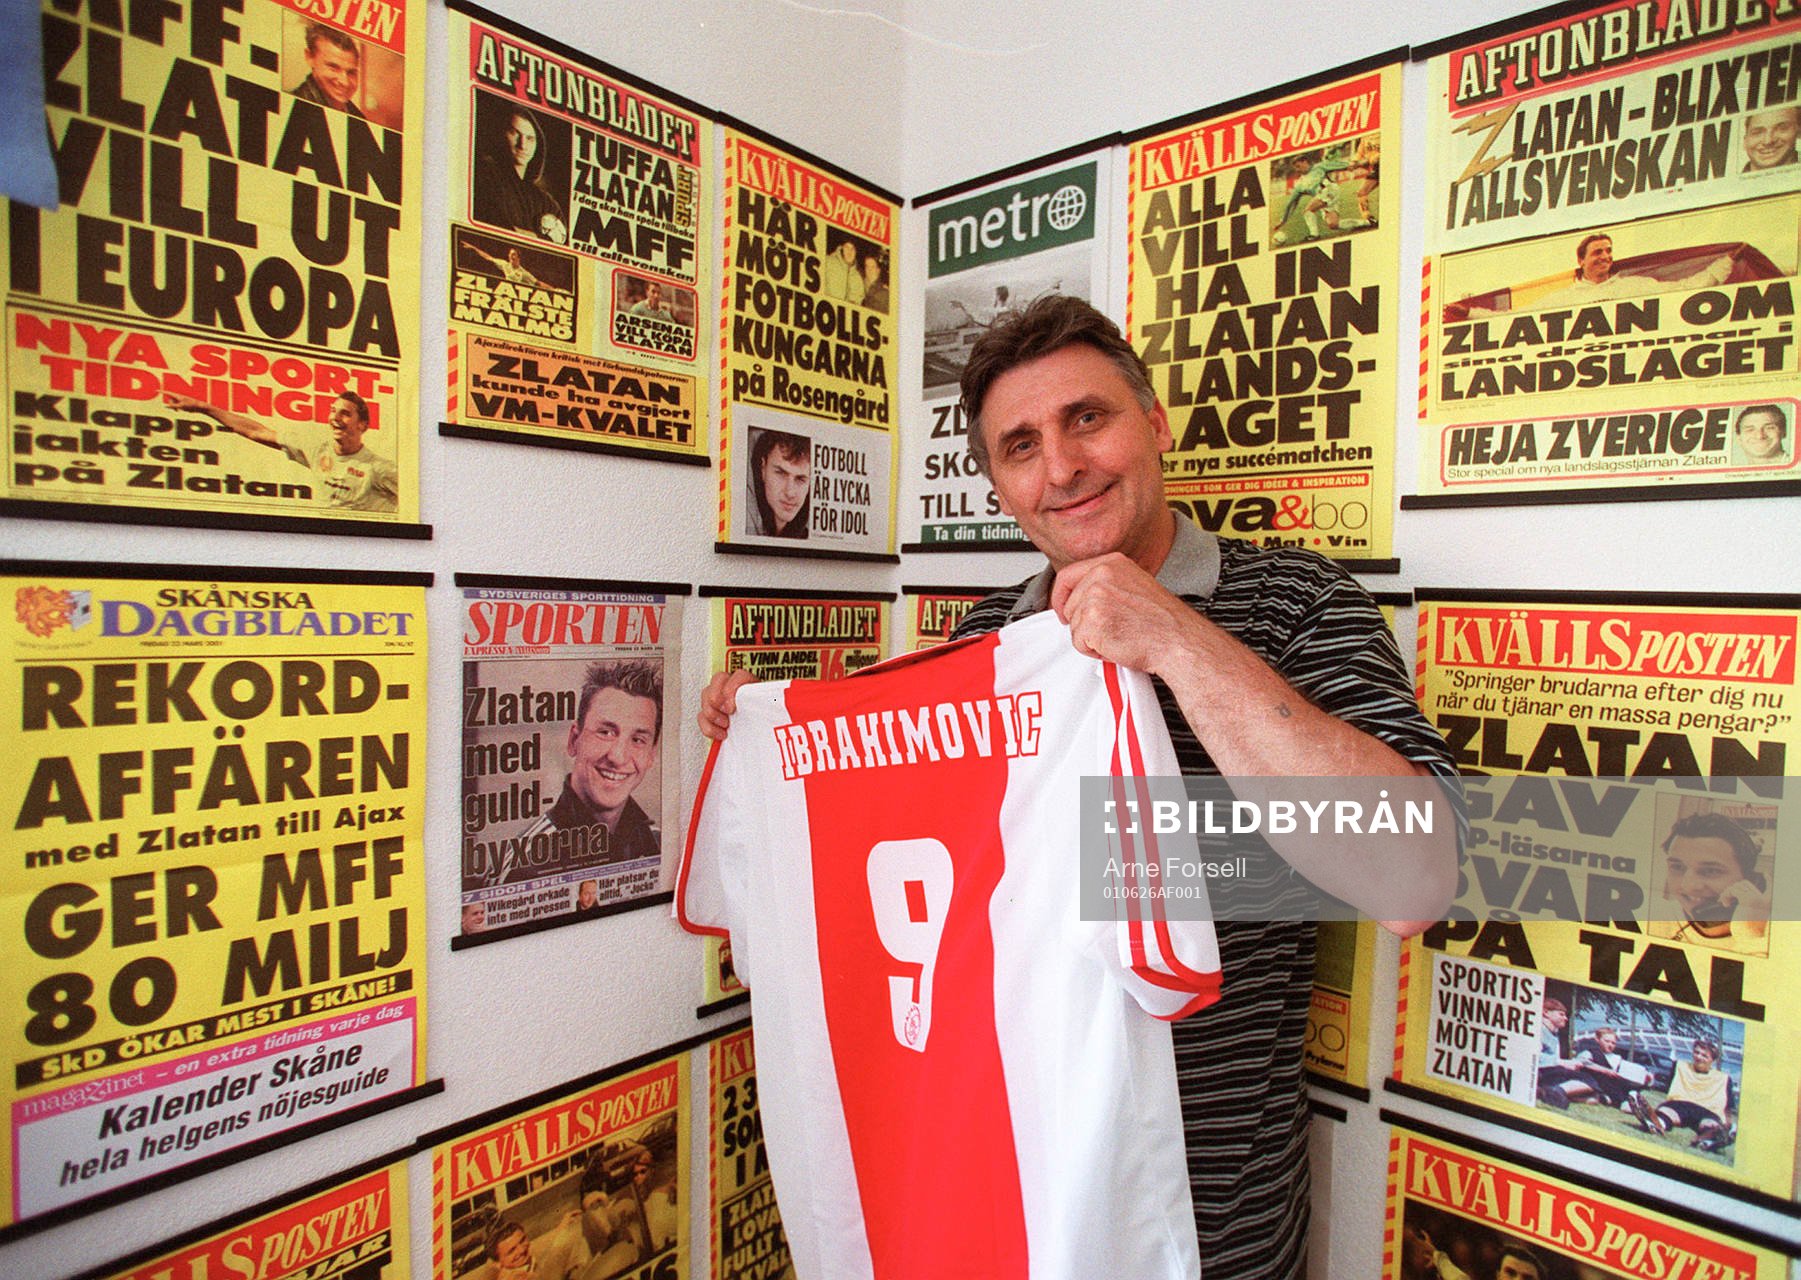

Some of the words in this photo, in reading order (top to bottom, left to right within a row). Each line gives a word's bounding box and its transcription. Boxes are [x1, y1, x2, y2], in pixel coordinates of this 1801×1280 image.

[475, 33, 696, 163] AFTONBLADET
[574, 125, 675, 193] TUFFA
[1143, 91, 1378, 189] KVÄLLSPOSTEN
[574, 160, 675, 223] ZLATAN
[738, 146, 890, 241] KVÄLLSPOSTEN
[1141, 165, 1266, 236] ALLA
[1446, 182, 1460, 230] I
[1462, 120, 1732, 228] ALLSVENSKAN
[291, 180, 401, 280] UT
[599, 200, 617, 213] ska
[618, 206, 635, 220] han
[737, 186, 818, 254] HÄR
[572, 206, 695, 270] MFF
[573, 241, 599, 255] till
[600, 249, 695, 283] allsvenskan
[735, 229, 821, 293] MÖTS
[1141, 214, 1259, 278] VILL
[76, 212, 401, 359] EUROPA
[455, 271, 574, 312] ZLATAN
[1156, 263, 1252, 320] HA
[1275, 240, 1352, 300] IN
[615, 313, 694, 339] ARSENAL
[615, 323, 648, 341] VILL
[651, 327, 693, 349] KÖPA
[735, 271, 889, 351] FOTBOLLS-
[1142, 285, 1380, 366] ZLATAN
[1442, 298, 1660, 357] ZLATAN
[1680, 282, 1795, 327] OM
[15, 313, 168, 370] NYA
[189, 344, 395, 395] SPORT-
[614, 332, 693, 358] ZLATAN
[733, 314, 888, 390] KUNGARNA
[1441, 335, 1794, 402] LANDSLAGET
[1443, 353, 1523, 369] sina
[1536, 326, 1761, 359] drömmar
[1779, 321, 1793, 333] i
[472, 374, 560, 400] kunde
[568, 388, 600, 407] ha
[608, 397, 691, 421] avgjort
[487, 353, 680, 405] ZLATAN
[733, 364, 766, 402] på
[772, 365, 889, 425] Rosengård
[1168, 340, 1377, 408] LANDS-
[14, 391, 234, 438] Klapp-
[471, 391, 692, 444] VM-KVALET
[1448, 423, 1538, 467] HEJA
[1546, 408, 1731, 461] ZVERIGE
[15, 460, 105, 486] på
[126, 465, 313, 499] Zlatan
[813, 443, 868, 477] FOTBOLL
[1184, 457, 1221, 476] nya
[1226, 441, 1373, 469] succématchen
[1225, 482, 1242, 493] GER
[1244, 480, 1260, 492] DIG
[1302, 474, 1366, 488] INSPIRATION
[1447, 466, 1470, 480] Stor
[1473, 464, 1515, 481] special
[1517, 465, 1537, 477] om
[1539, 462, 1562, 478] nya
[1564, 453, 1679, 476] landslagsstjärnan
[1682, 453, 1728, 467] Zlatan
[812, 470, 831, 501] ÄR
[833, 480, 871, 507] LYCKA
[920, 492, 975, 520] TILL
[812, 502, 838, 533] FÖR
[840, 510, 869, 536] IDOL
[933, 526, 949, 541] Ta
[954, 522, 976, 541] din
[1327, 535, 1368, 547] Vin
[99, 599, 413, 637] DAGBLADET
[155, 583, 315, 610] SKÅNSKA
[479, 589, 568, 601] SYDSVERIGES
[572, 591, 655, 603] SPORTTIDNING
[729, 600, 878, 644] AFTONBLADET
[463, 600, 667, 647] SPORTEN
[1440, 611, 1792, 679] KVÄLLSPOSTEN
[749, 651, 781, 666] VINN
[781, 650, 819, 666] ANDEL
[22, 660, 410, 732] REKORD-
[464, 684, 577, 729] Zlatan
[1436, 692, 1469, 709] när
[1473, 694, 1498, 712] du
[1502, 696, 1563, 718] tjänar
[1568, 704, 1594, 720] en
[1599, 706, 1672, 726] massa
[1539, 675, 1637, 700] brudarna
[1644, 683, 1703, 702] efter
[1710, 685, 1745, 710] dig
[1752, 693, 1784, 709] nu
[464, 732, 542, 780] med
[773, 691, 1042, 782] IBRAHIMOVIC
[1437, 714, 1788, 800] ZLATAN
[14, 724, 410, 831] AFFÄREN
[464, 780, 554, 834] guld-
[25, 832, 119, 870] med
[137, 823, 261, 855] Zlatan
[275, 809, 321, 837] till
[333, 803, 406, 833] Ajax
[463, 821, 611, 880] byxorna
[24, 865, 224, 961] GER
[257, 835, 404, 922] MFF
[462, 893, 473, 904] 7
[479, 884, 528, 899] SIDOR
[530, 875, 568, 891] SPEL
[486, 892, 536, 914] Wikegård
[537, 886, 571, 905] orkade
[616, 872, 648, 890] platsar
[648, 868, 661, 880] du
[486, 913, 508, 927] inte
[508, 908, 532, 923] med
[532, 899, 571, 920] pressen
[866, 837, 955, 1054] 9
[1422, 903, 1538, 970] PÅ
[1579, 929, 1766, 1023] TAL
[24, 956, 178, 1048] 80
[221, 907, 409, 1007] MILJ
[1439, 960, 1542, 1006] SPORTIS-
[41, 1046, 107, 1080] SkD
[118, 1024, 206, 1060] ÖKAR
[215, 1003, 284, 1038] MEST
[291, 1000, 301, 1017] I
[309, 976, 398, 1012] SKÅNE!
[174, 1058, 201, 1079] en
[206, 1042, 259, 1068] extra
[263, 1023, 324, 1056] tidning
[328, 1013, 373, 1042] varje
[375, 1003, 405, 1030] dag
[1435, 1018, 1509, 1061] MÖTTE
[1437, 990, 1536, 1038] VINNARE
[98, 1071, 264, 1141] Kalender
[269, 1044, 364, 1088] Skåne
[1432, 1049, 1513, 1096] ZLATAN
[59, 1146, 129, 1189] hela
[137, 1104, 252, 1163] helgens
[256, 1064, 391, 1128] nöjesguide
[454, 1074, 677, 1196] KVÄLLSPOSTEN
